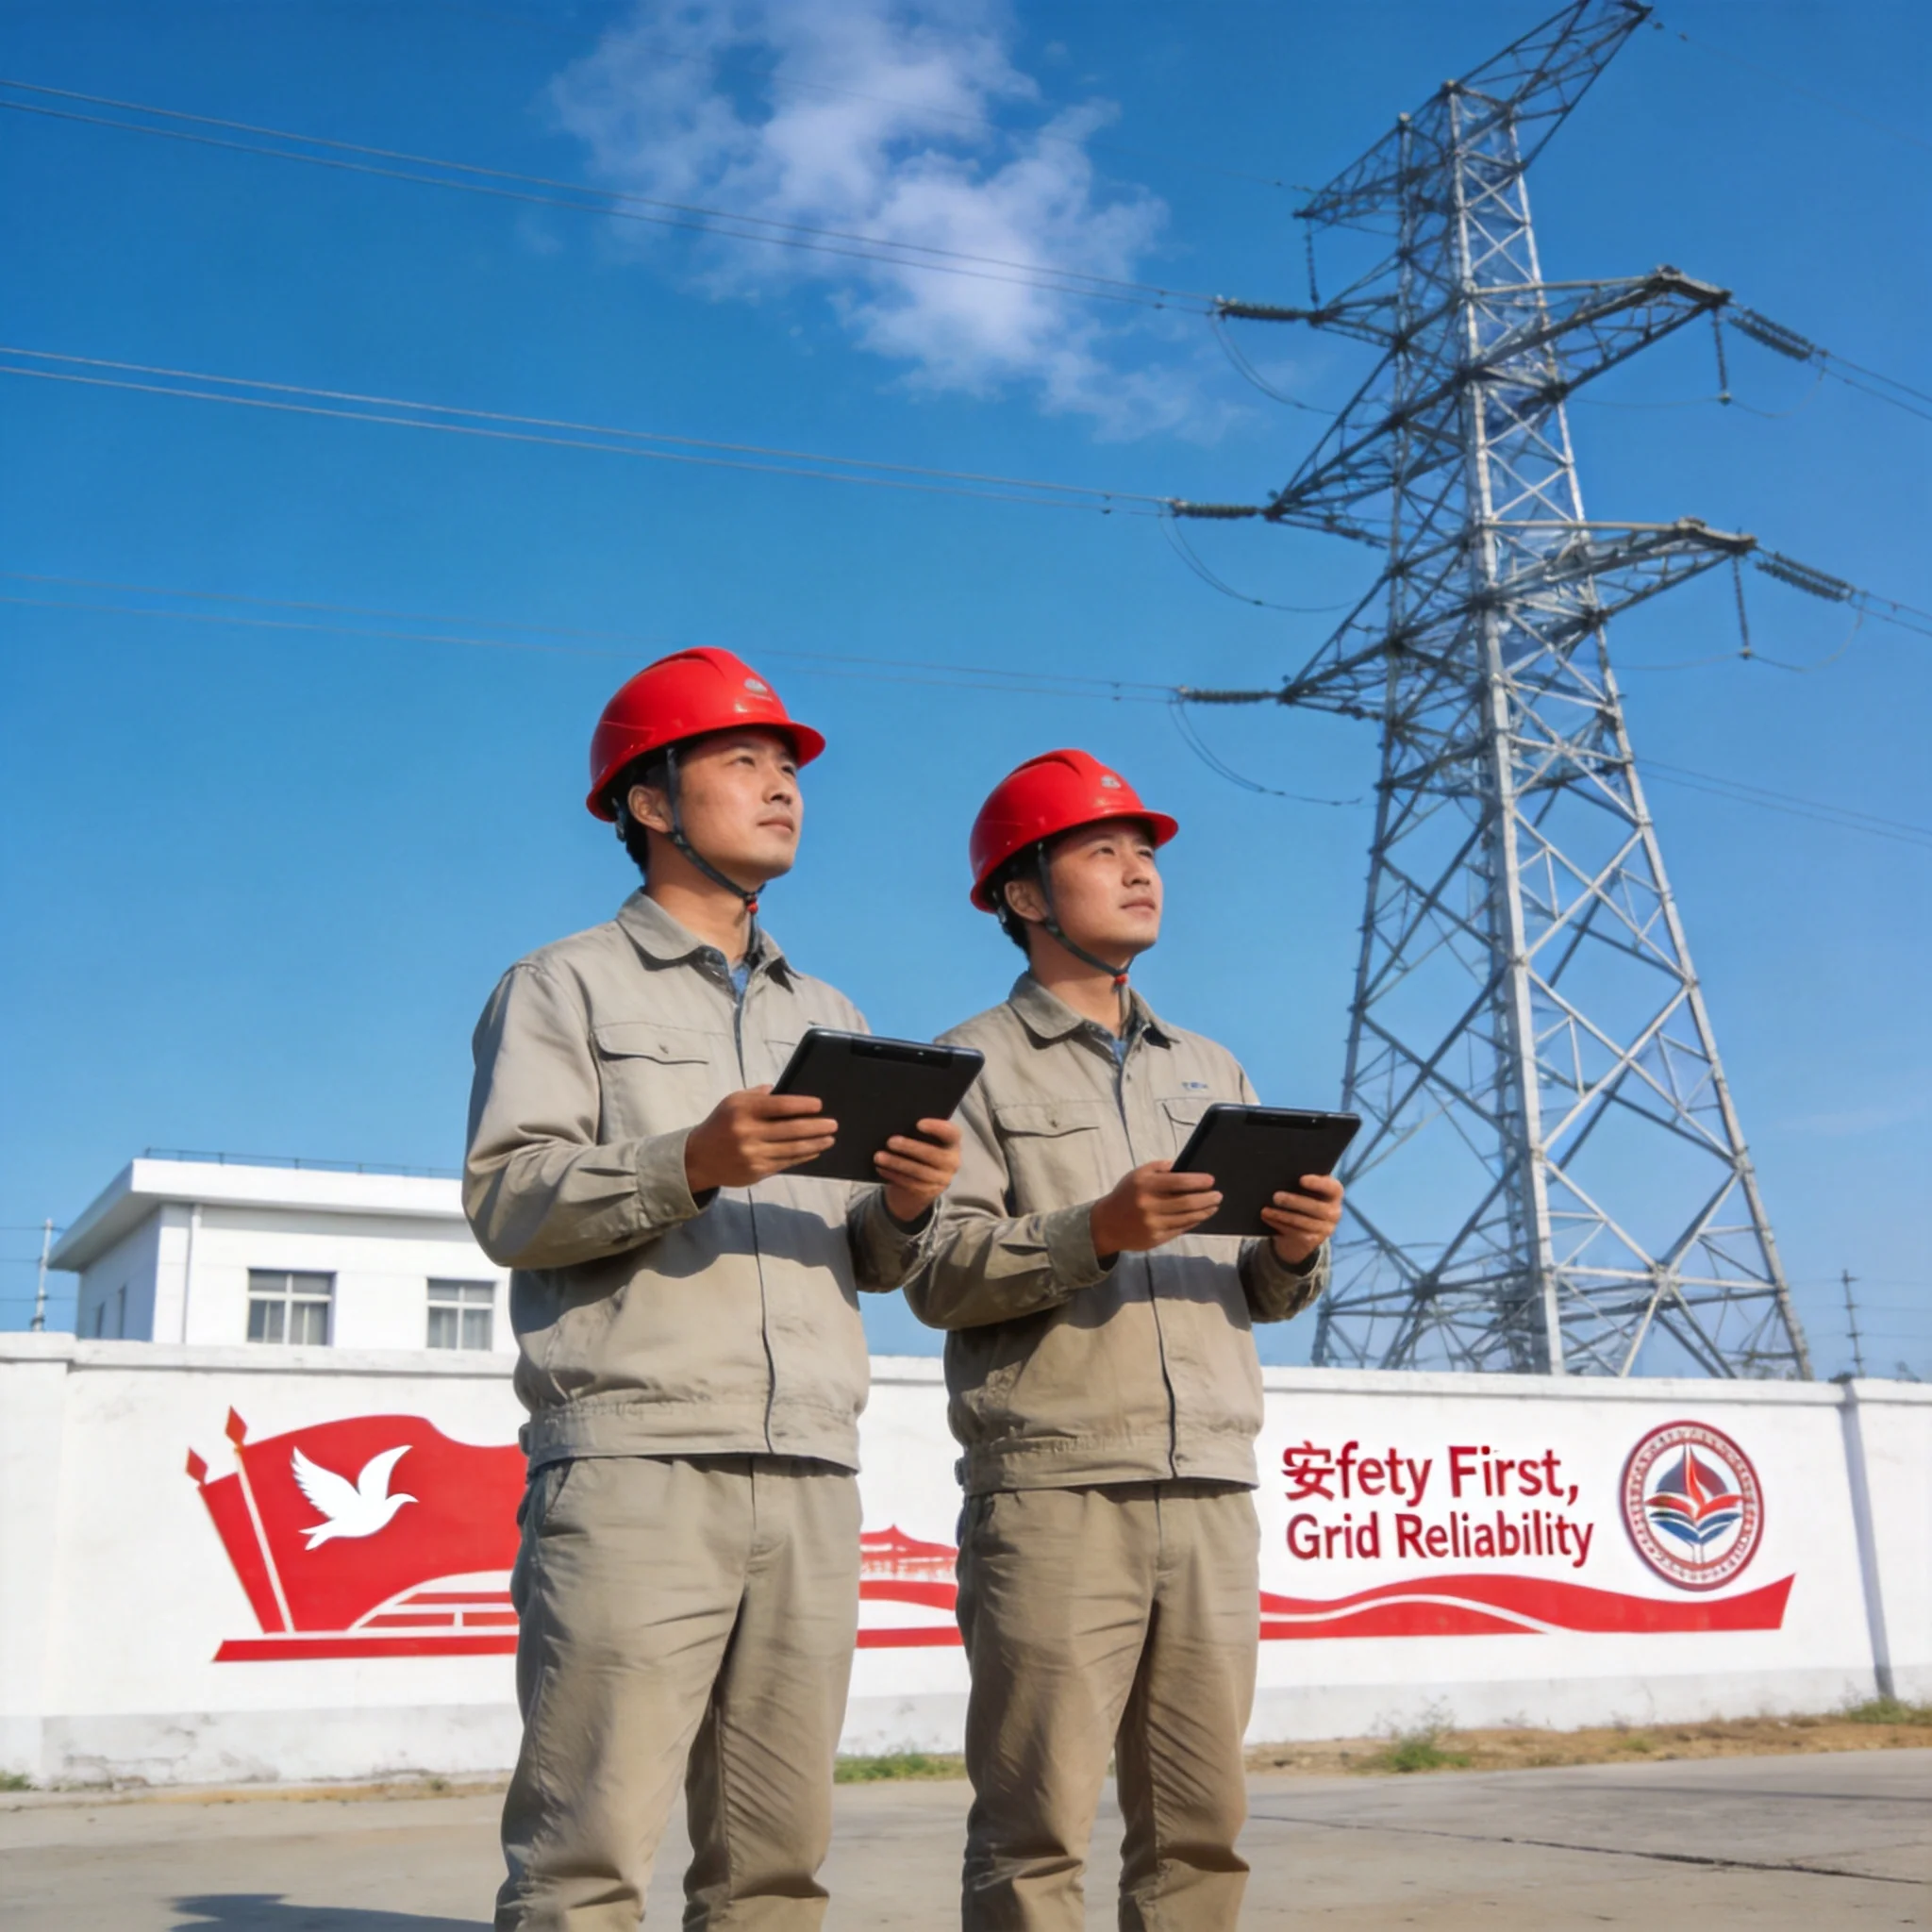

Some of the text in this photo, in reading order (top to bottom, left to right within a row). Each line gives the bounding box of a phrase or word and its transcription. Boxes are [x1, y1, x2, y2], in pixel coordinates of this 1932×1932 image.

[1448, 1444, 1579, 1506] First,
[1287, 1508, 1593, 1568] Grid Reliability
